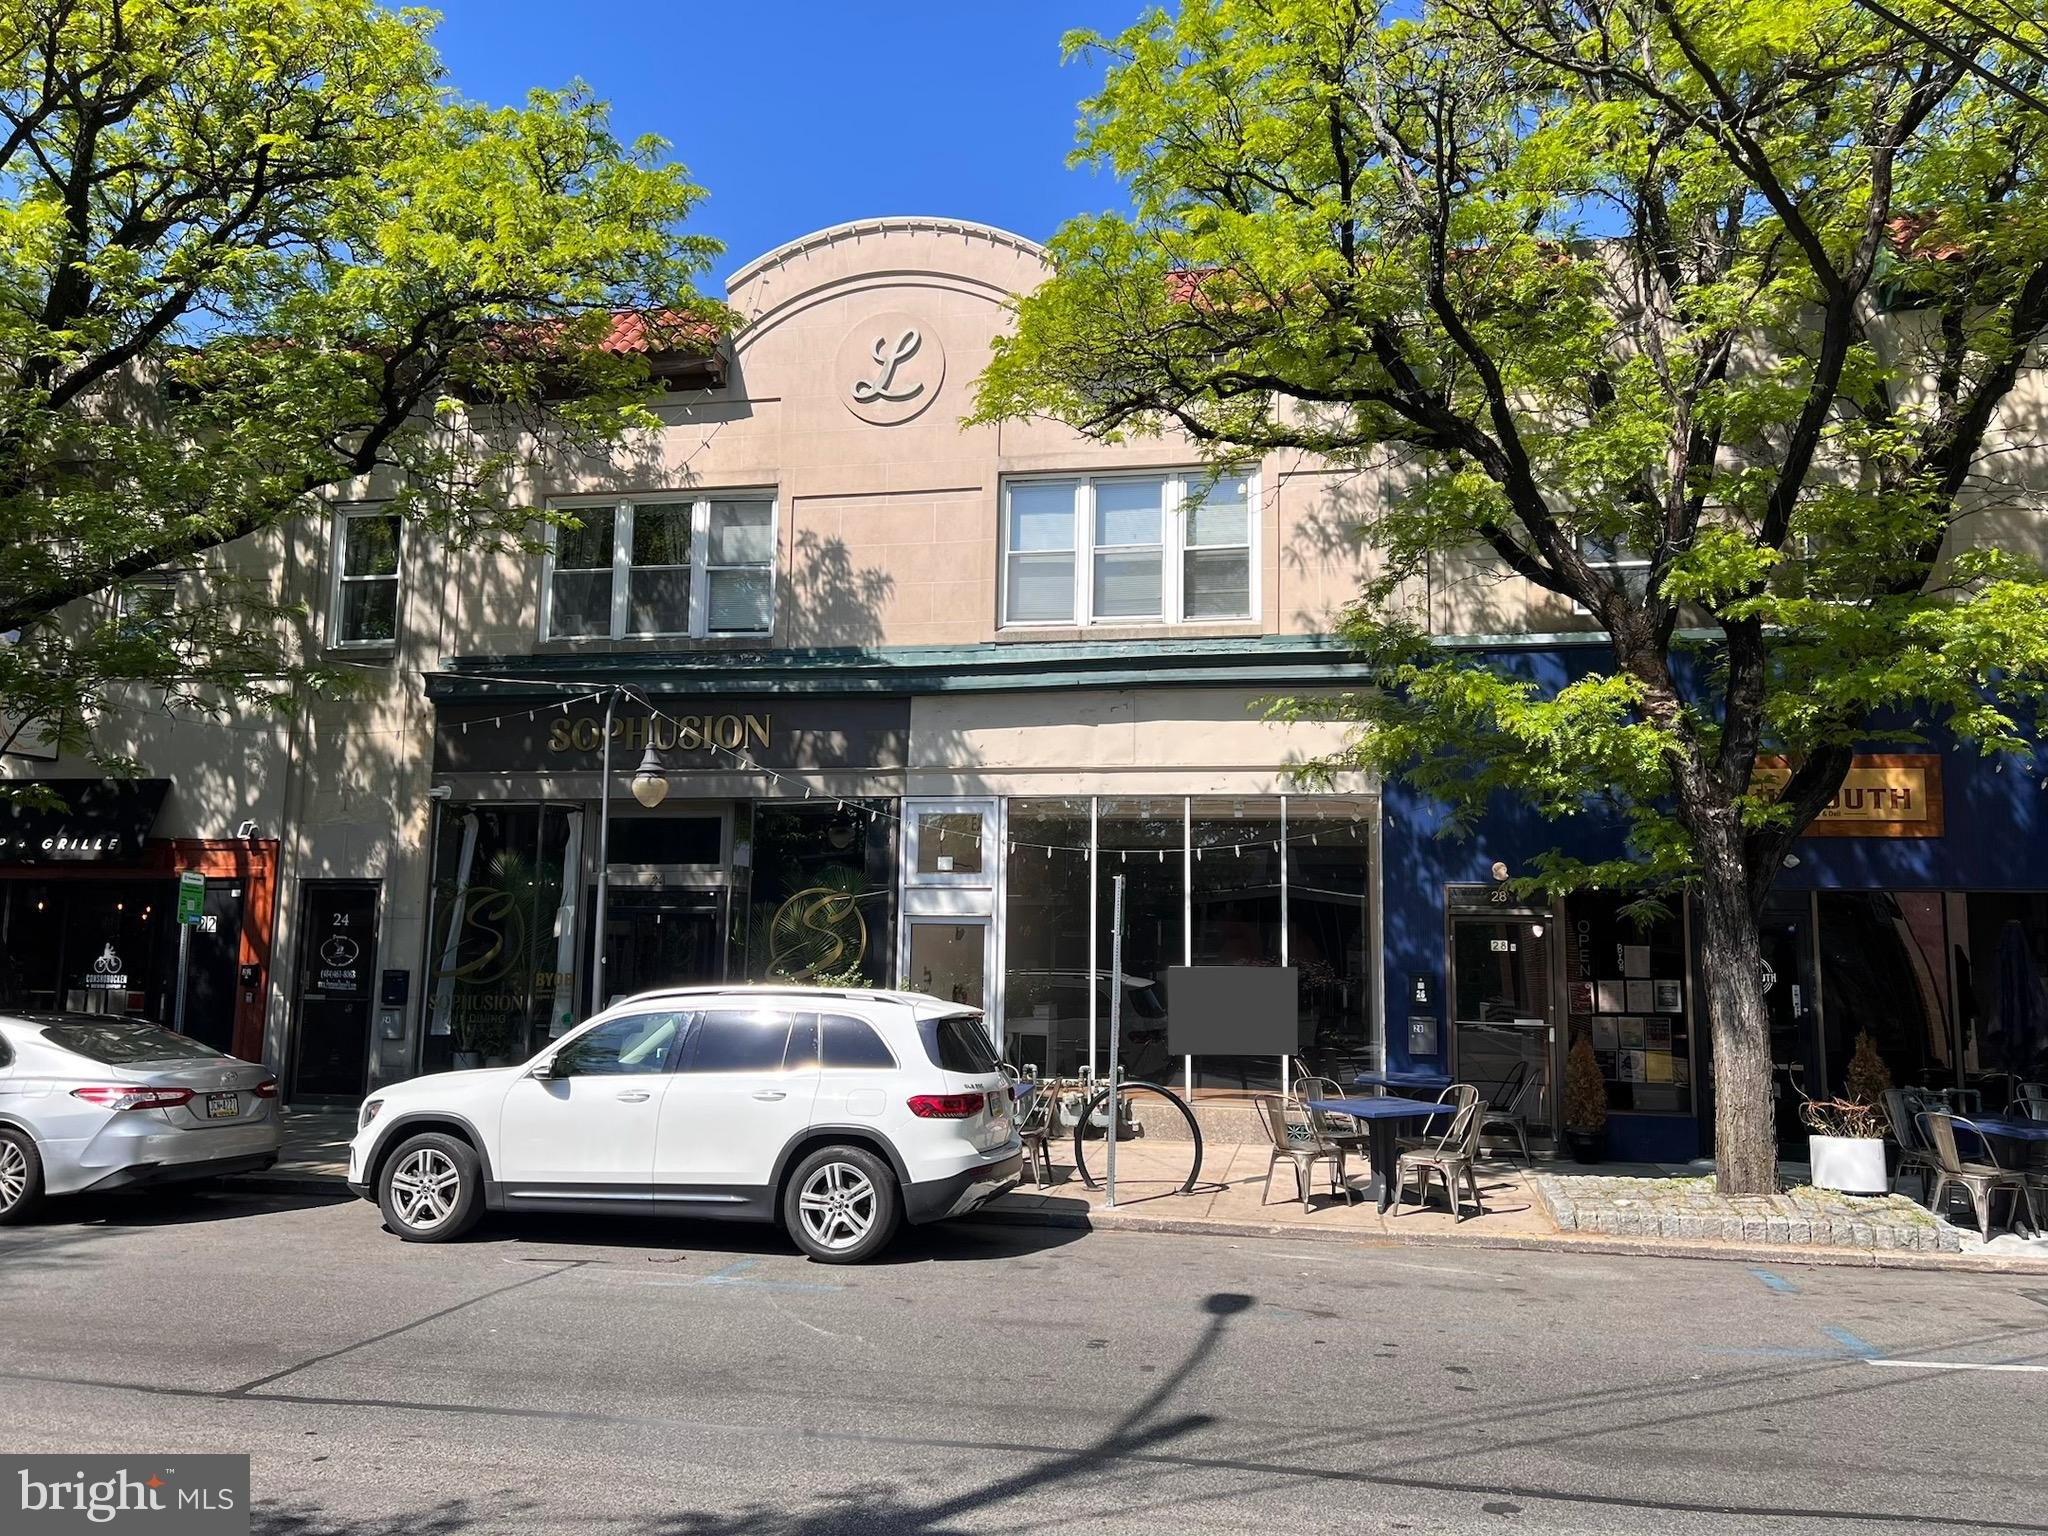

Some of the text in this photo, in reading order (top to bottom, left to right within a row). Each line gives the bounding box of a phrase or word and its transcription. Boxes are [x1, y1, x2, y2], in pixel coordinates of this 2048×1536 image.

[850, 328, 924, 404] L
[548, 713, 770, 751] SOPHUSION
[41, 838, 118, 850] GRILLE
[1490, 890, 1507, 902] 28
[333, 912, 350, 926] 24
[1491, 941, 1507, 951] 28
[1578, 919, 1590, 977] OPEN
